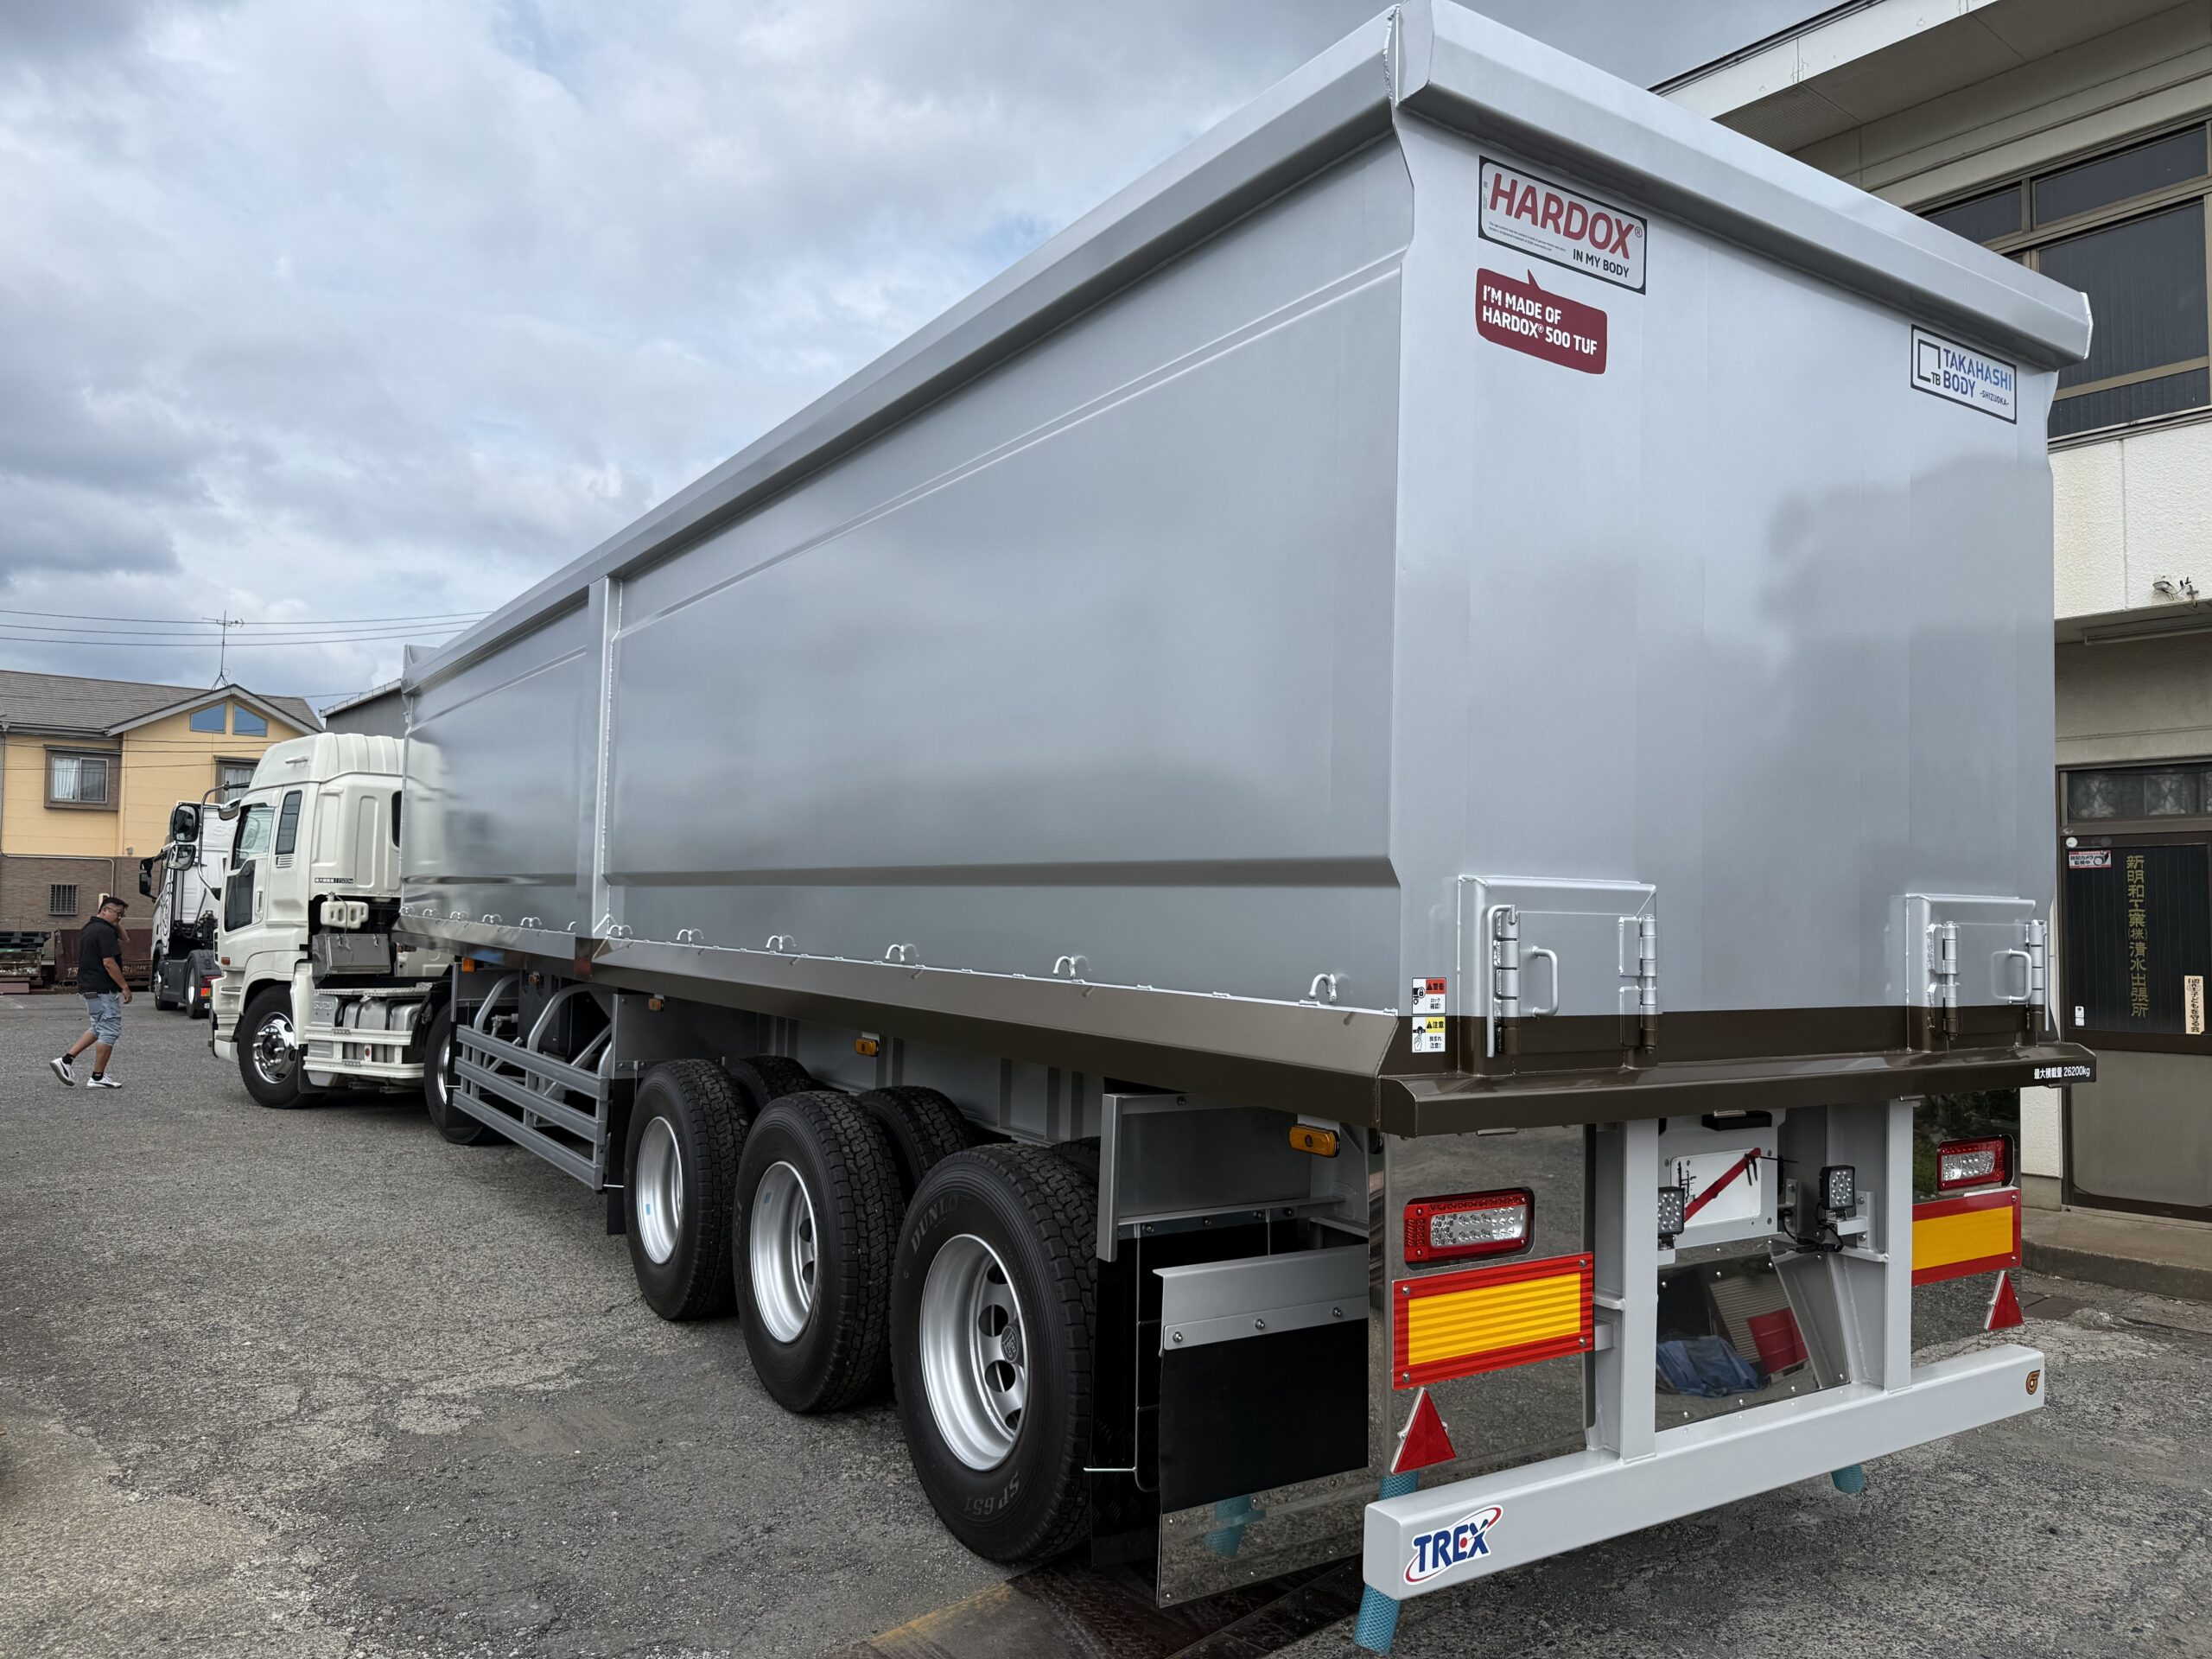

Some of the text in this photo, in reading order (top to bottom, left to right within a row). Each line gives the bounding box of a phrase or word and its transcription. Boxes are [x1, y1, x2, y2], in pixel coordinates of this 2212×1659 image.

[1573, 248, 1630, 278] IN MY BODY
[1482, 284, 1562, 325] I'M MADE OF
[1545, 327, 1571, 348] 500
[1573, 334, 1598, 355] TUF
[1930, 372, 1941, 386] TB
[1943, 348, 2012, 392] TAKAHASHI
[1943, 370, 1976, 398] BODY
[2063, 1065, 2091, 1077] 26200kg
[1413, 1518, 1490, 1573] TREX
